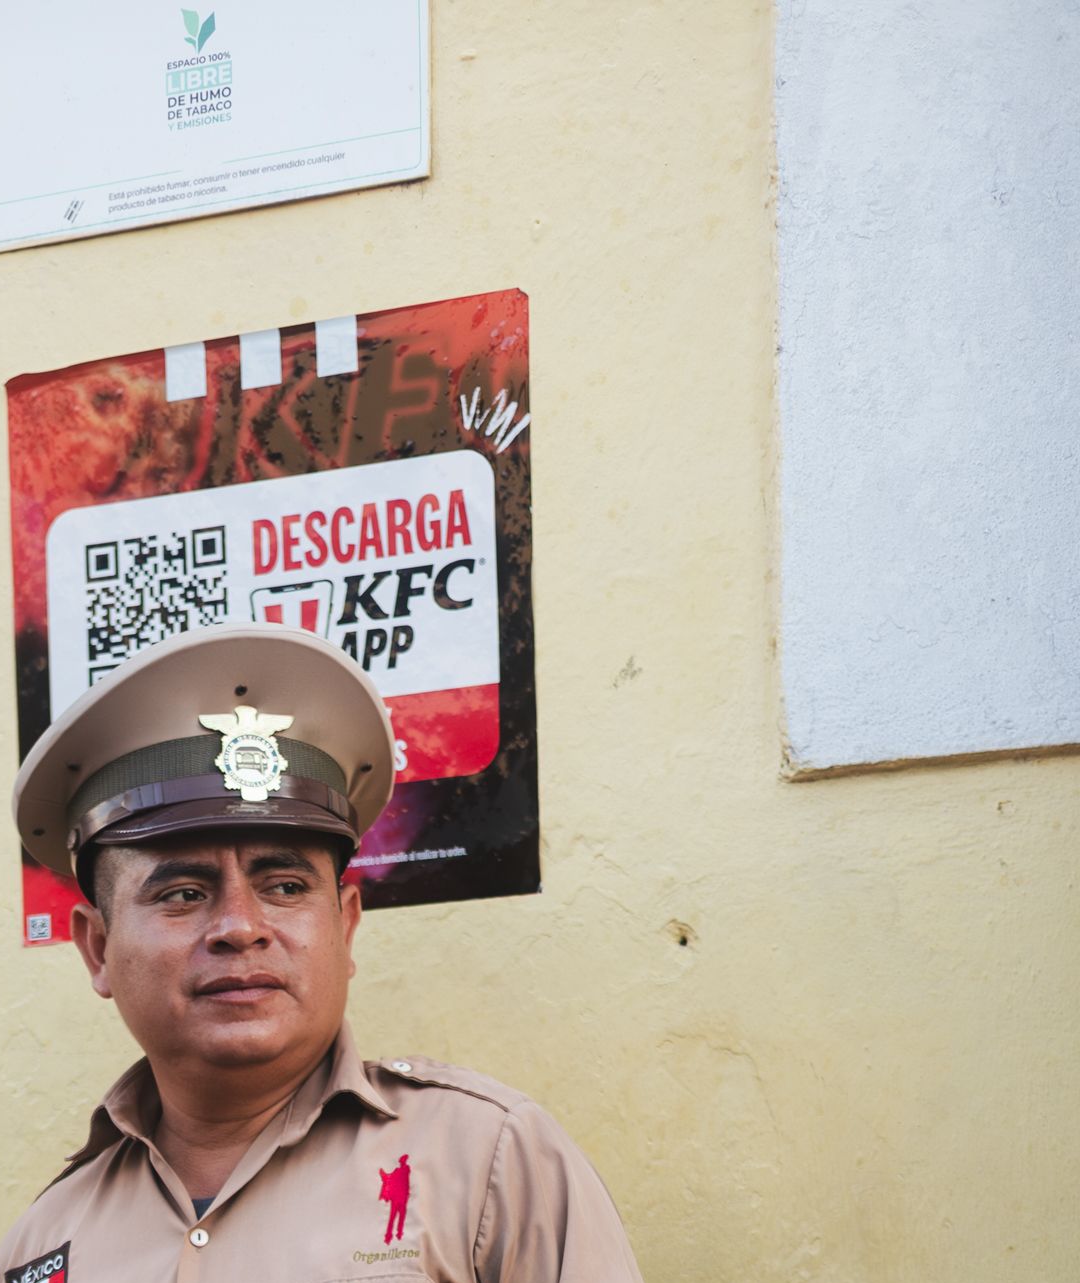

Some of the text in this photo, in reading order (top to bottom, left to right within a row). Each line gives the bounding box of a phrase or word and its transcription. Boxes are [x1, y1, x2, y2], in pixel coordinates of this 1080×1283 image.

[167, 50, 231, 70] ESPACIO 100%
[168, 63, 231, 94] LIBRE
[168, 86, 232, 108] DE HUMO
[168, 100, 232, 120] DE TABACO
[168, 112, 232, 131] Y EMISIONES
[126, 183, 166, 199] prohibido
[193, 171, 231, 186] consumir
[239, 166, 260, 177] tener
[261, 158, 306, 173] encendido
[307, 151, 345, 167] cualquier
[108, 199, 145, 214] producto
[146, 197, 156, 206] de
[158, 192, 185, 204] tabaco
[186, 191, 193, 199] o
[252, 489, 472, 576] DESCARGA
[337, 559, 475, 625] KFC
[353, 1248, 421, 1264] Organilleros
